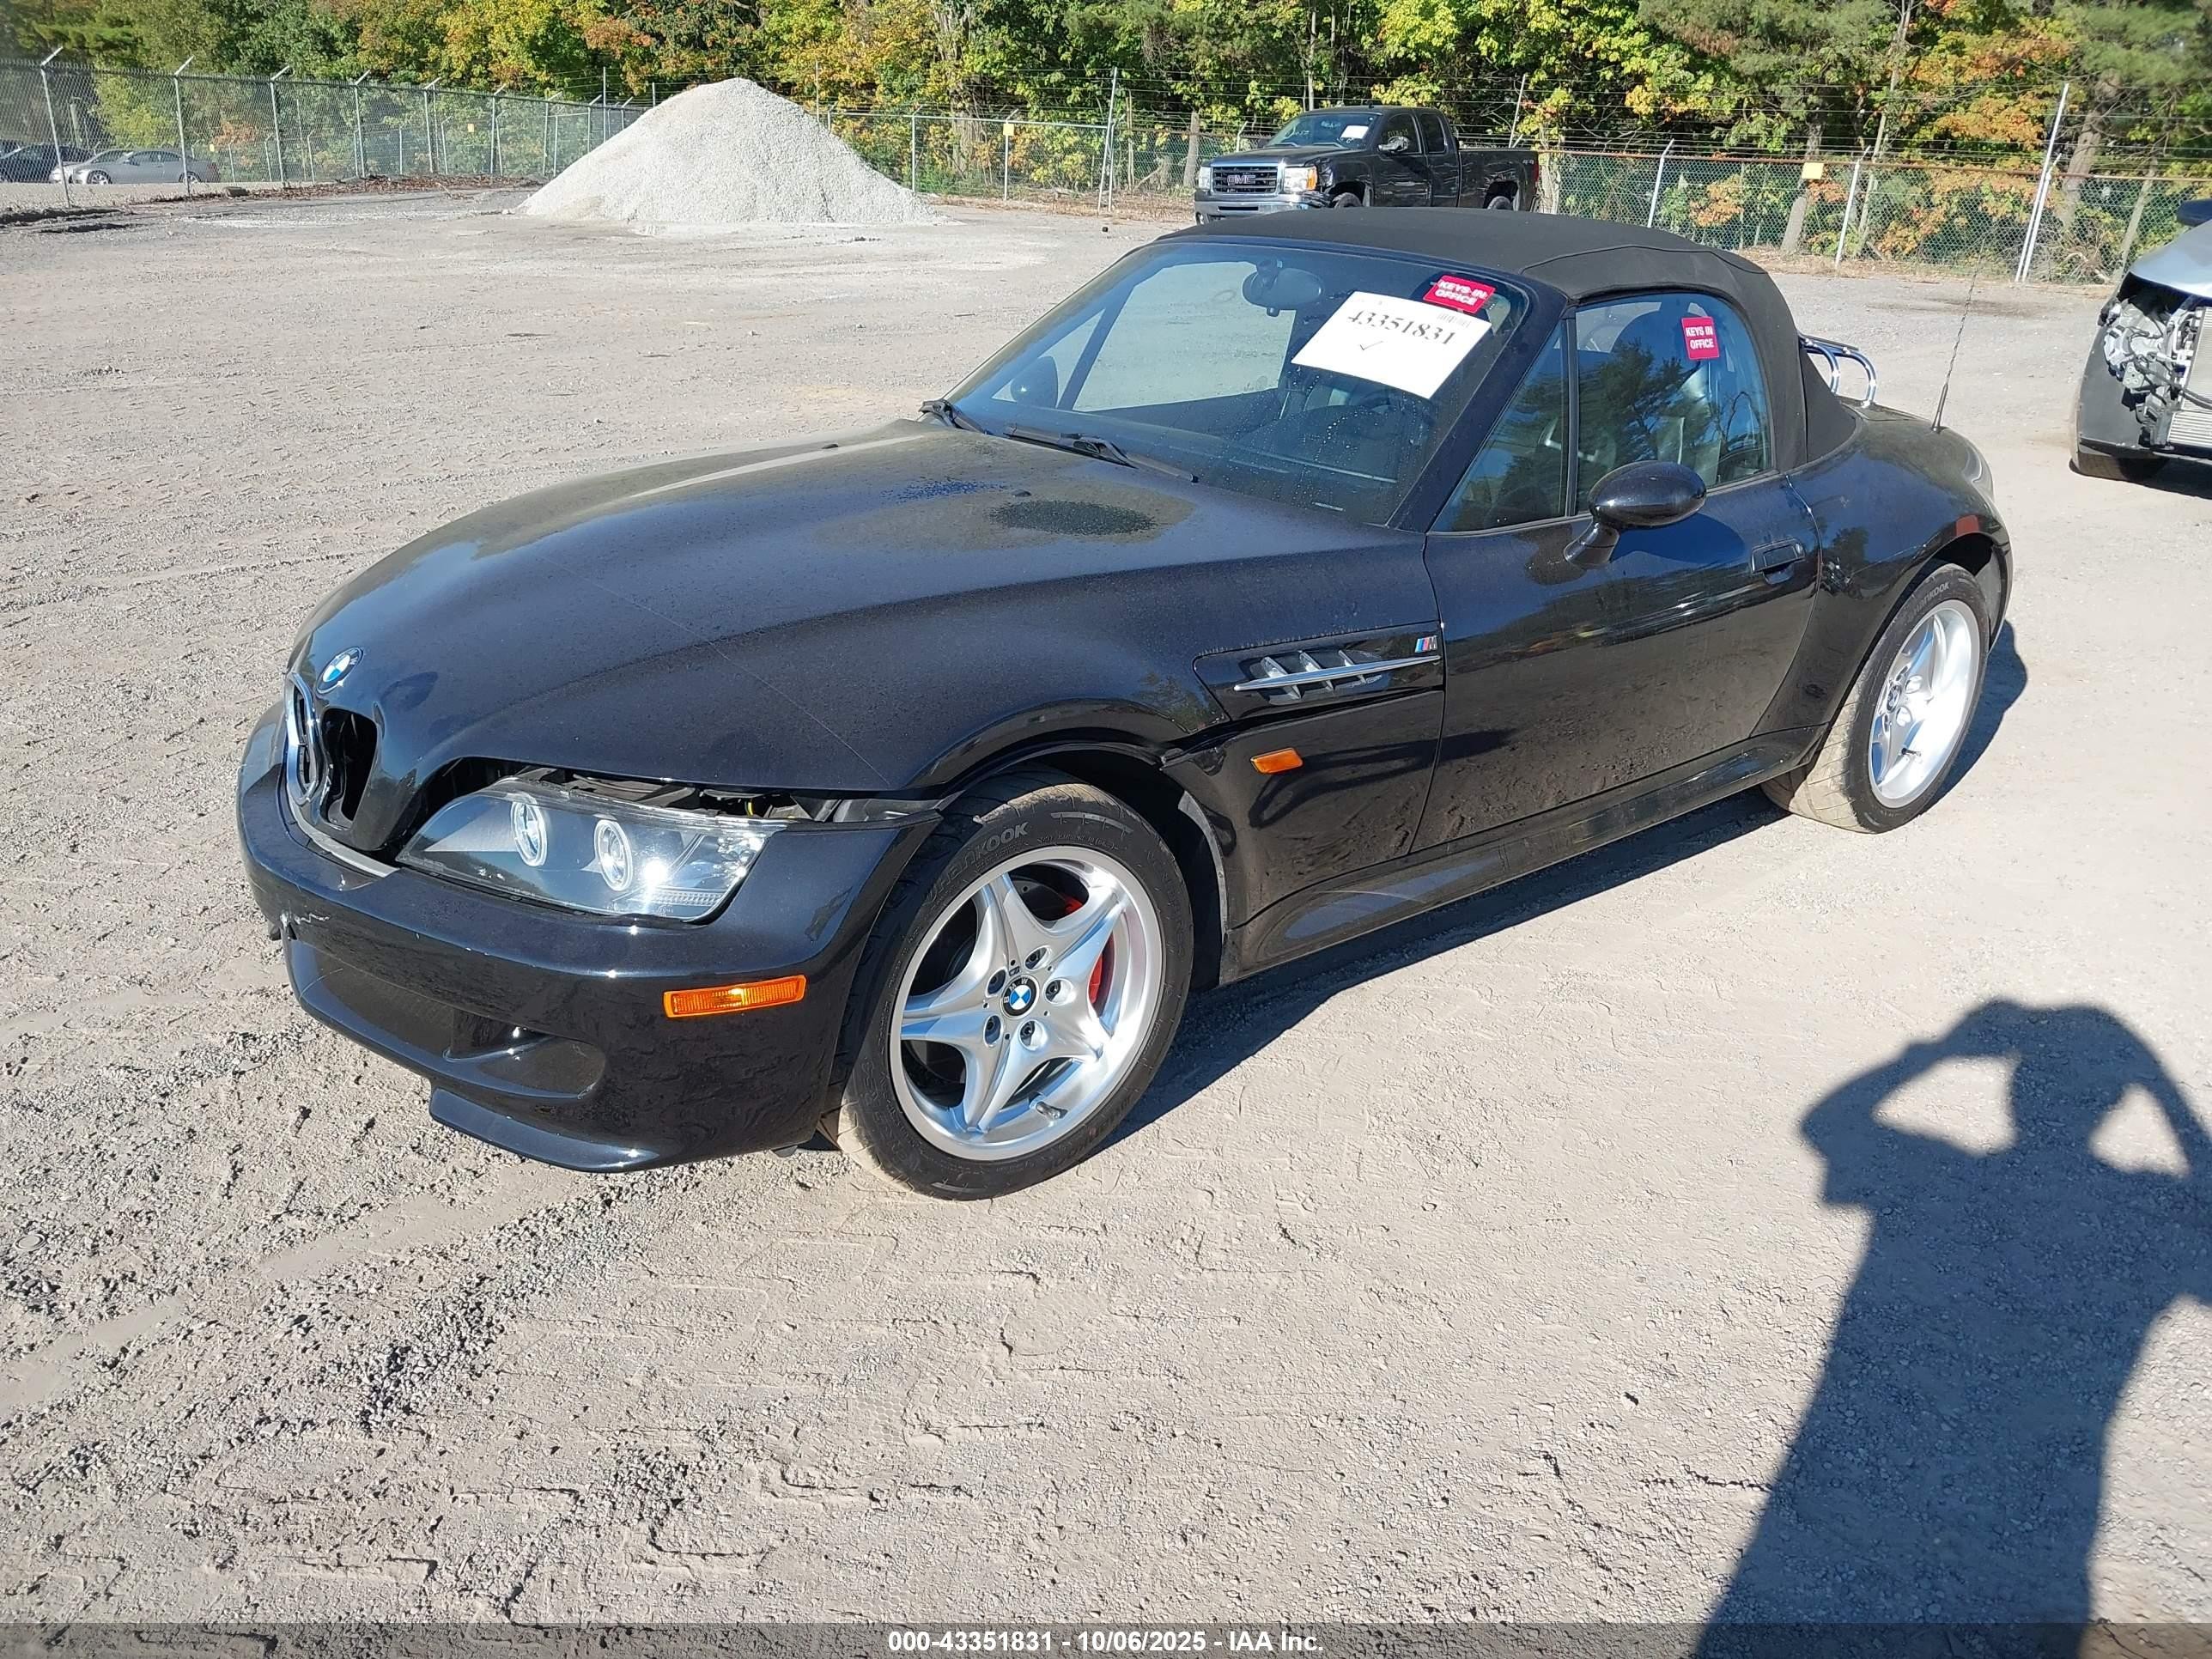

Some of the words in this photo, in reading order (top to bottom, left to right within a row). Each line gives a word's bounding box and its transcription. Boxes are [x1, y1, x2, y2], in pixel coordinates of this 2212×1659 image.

[1227, 174, 1256, 186] GMC
[1434, 289, 1478, 307] OFFICE
[1437, 280, 1473, 294] KEYS
[1471, 289, 1488, 301] IN
[1347, 309, 1457, 345] 43351831
[1685, 325, 1705, 337] KEYS
[1705, 325, 1714, 336] IN
[1689, 338, 1715, 349] OFFICE
